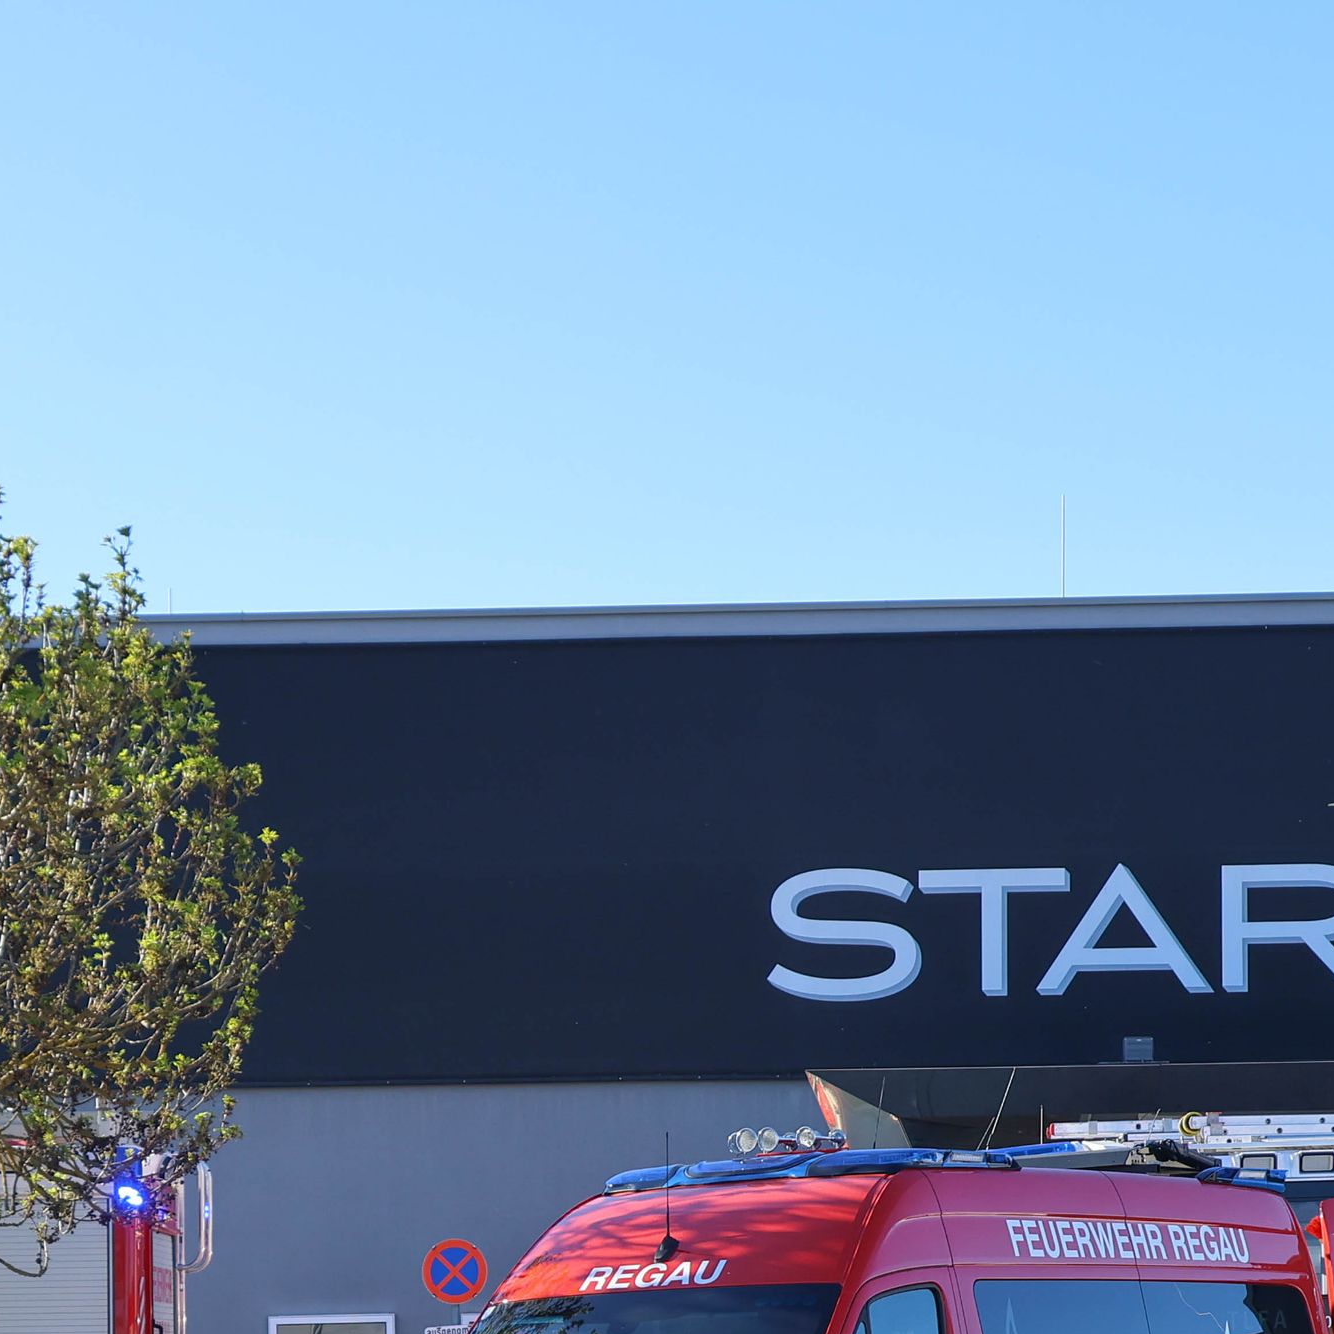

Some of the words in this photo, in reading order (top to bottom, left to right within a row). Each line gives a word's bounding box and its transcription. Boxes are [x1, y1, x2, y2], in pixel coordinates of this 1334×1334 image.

[1006, 1219, 1166, 1261] FEUERWEHR
[1167, 1223, 1250, 1265] REGAU
[579, 1258, 727, 1293] REGAU
